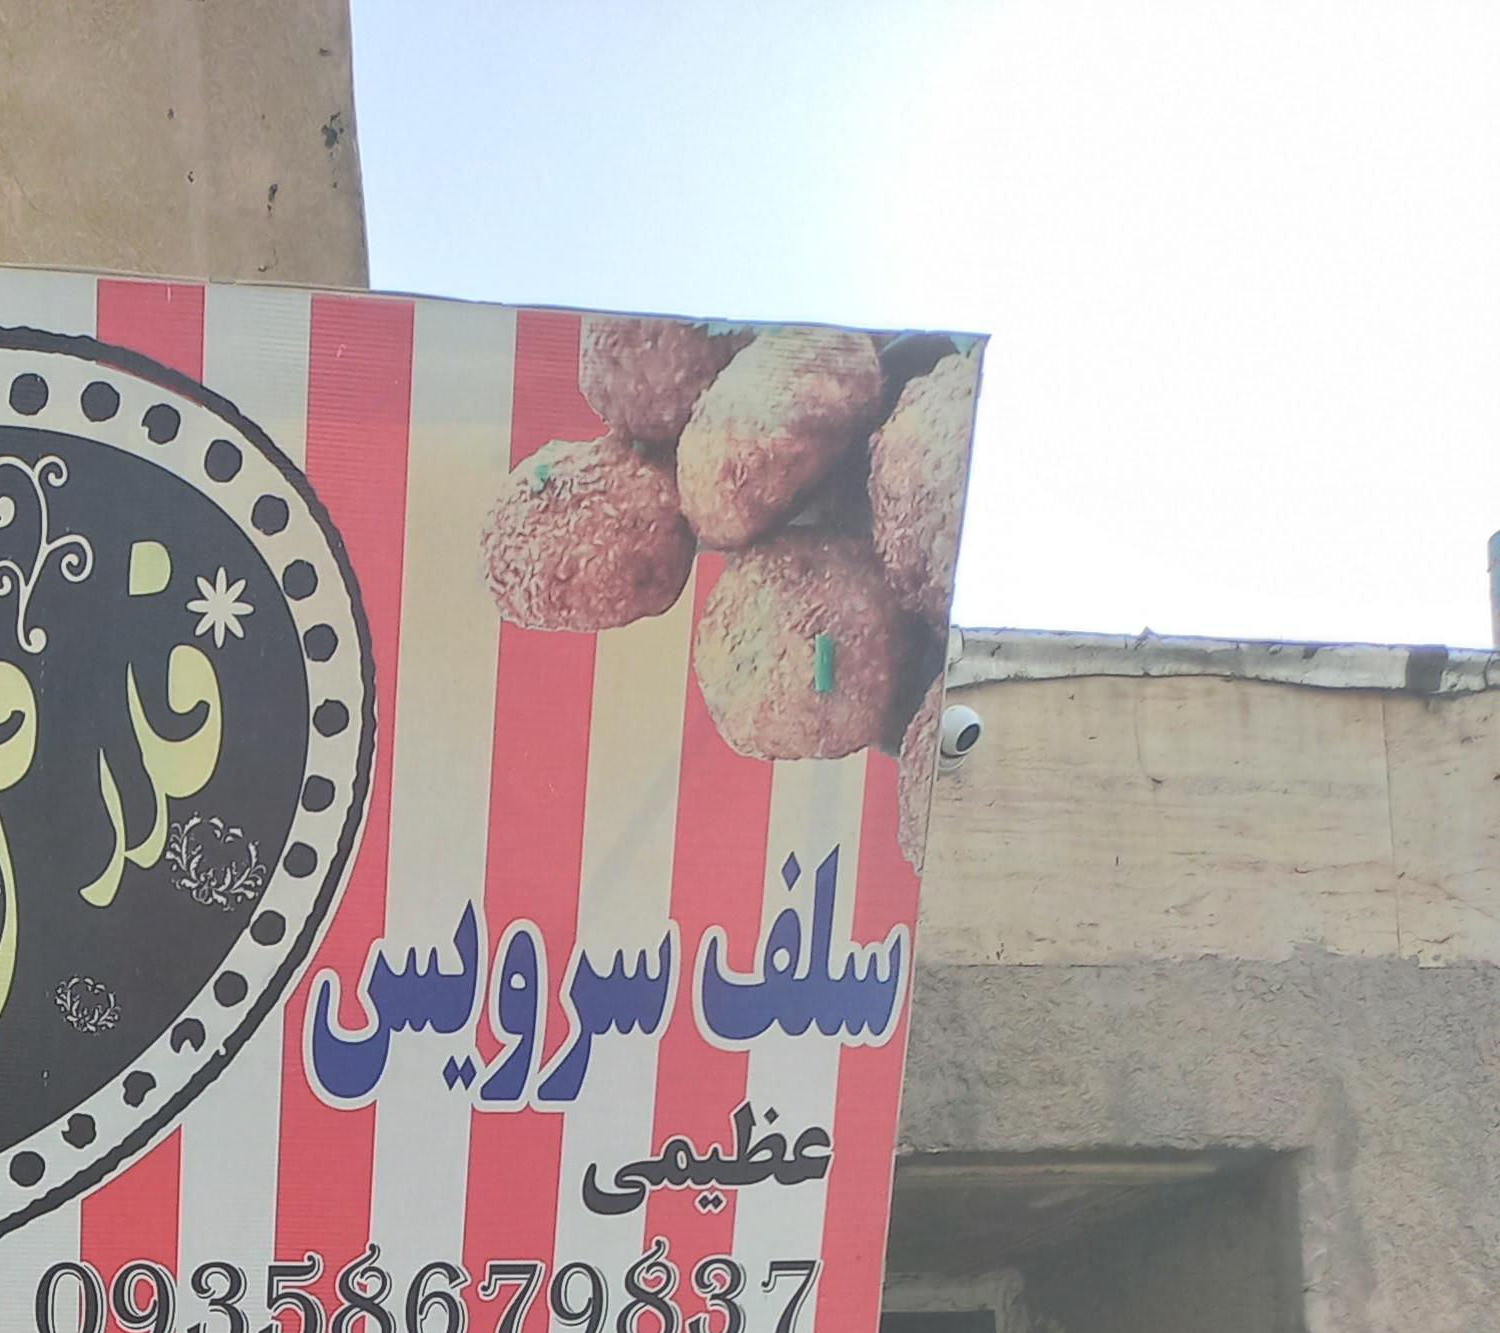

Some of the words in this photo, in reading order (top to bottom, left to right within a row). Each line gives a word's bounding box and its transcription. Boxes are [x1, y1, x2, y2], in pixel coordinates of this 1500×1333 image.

[311, 899, 673, 1101] سرویس
[701, 845, 904, 1042] سلف
[584, 1102, 832, 1214] عظیمی
